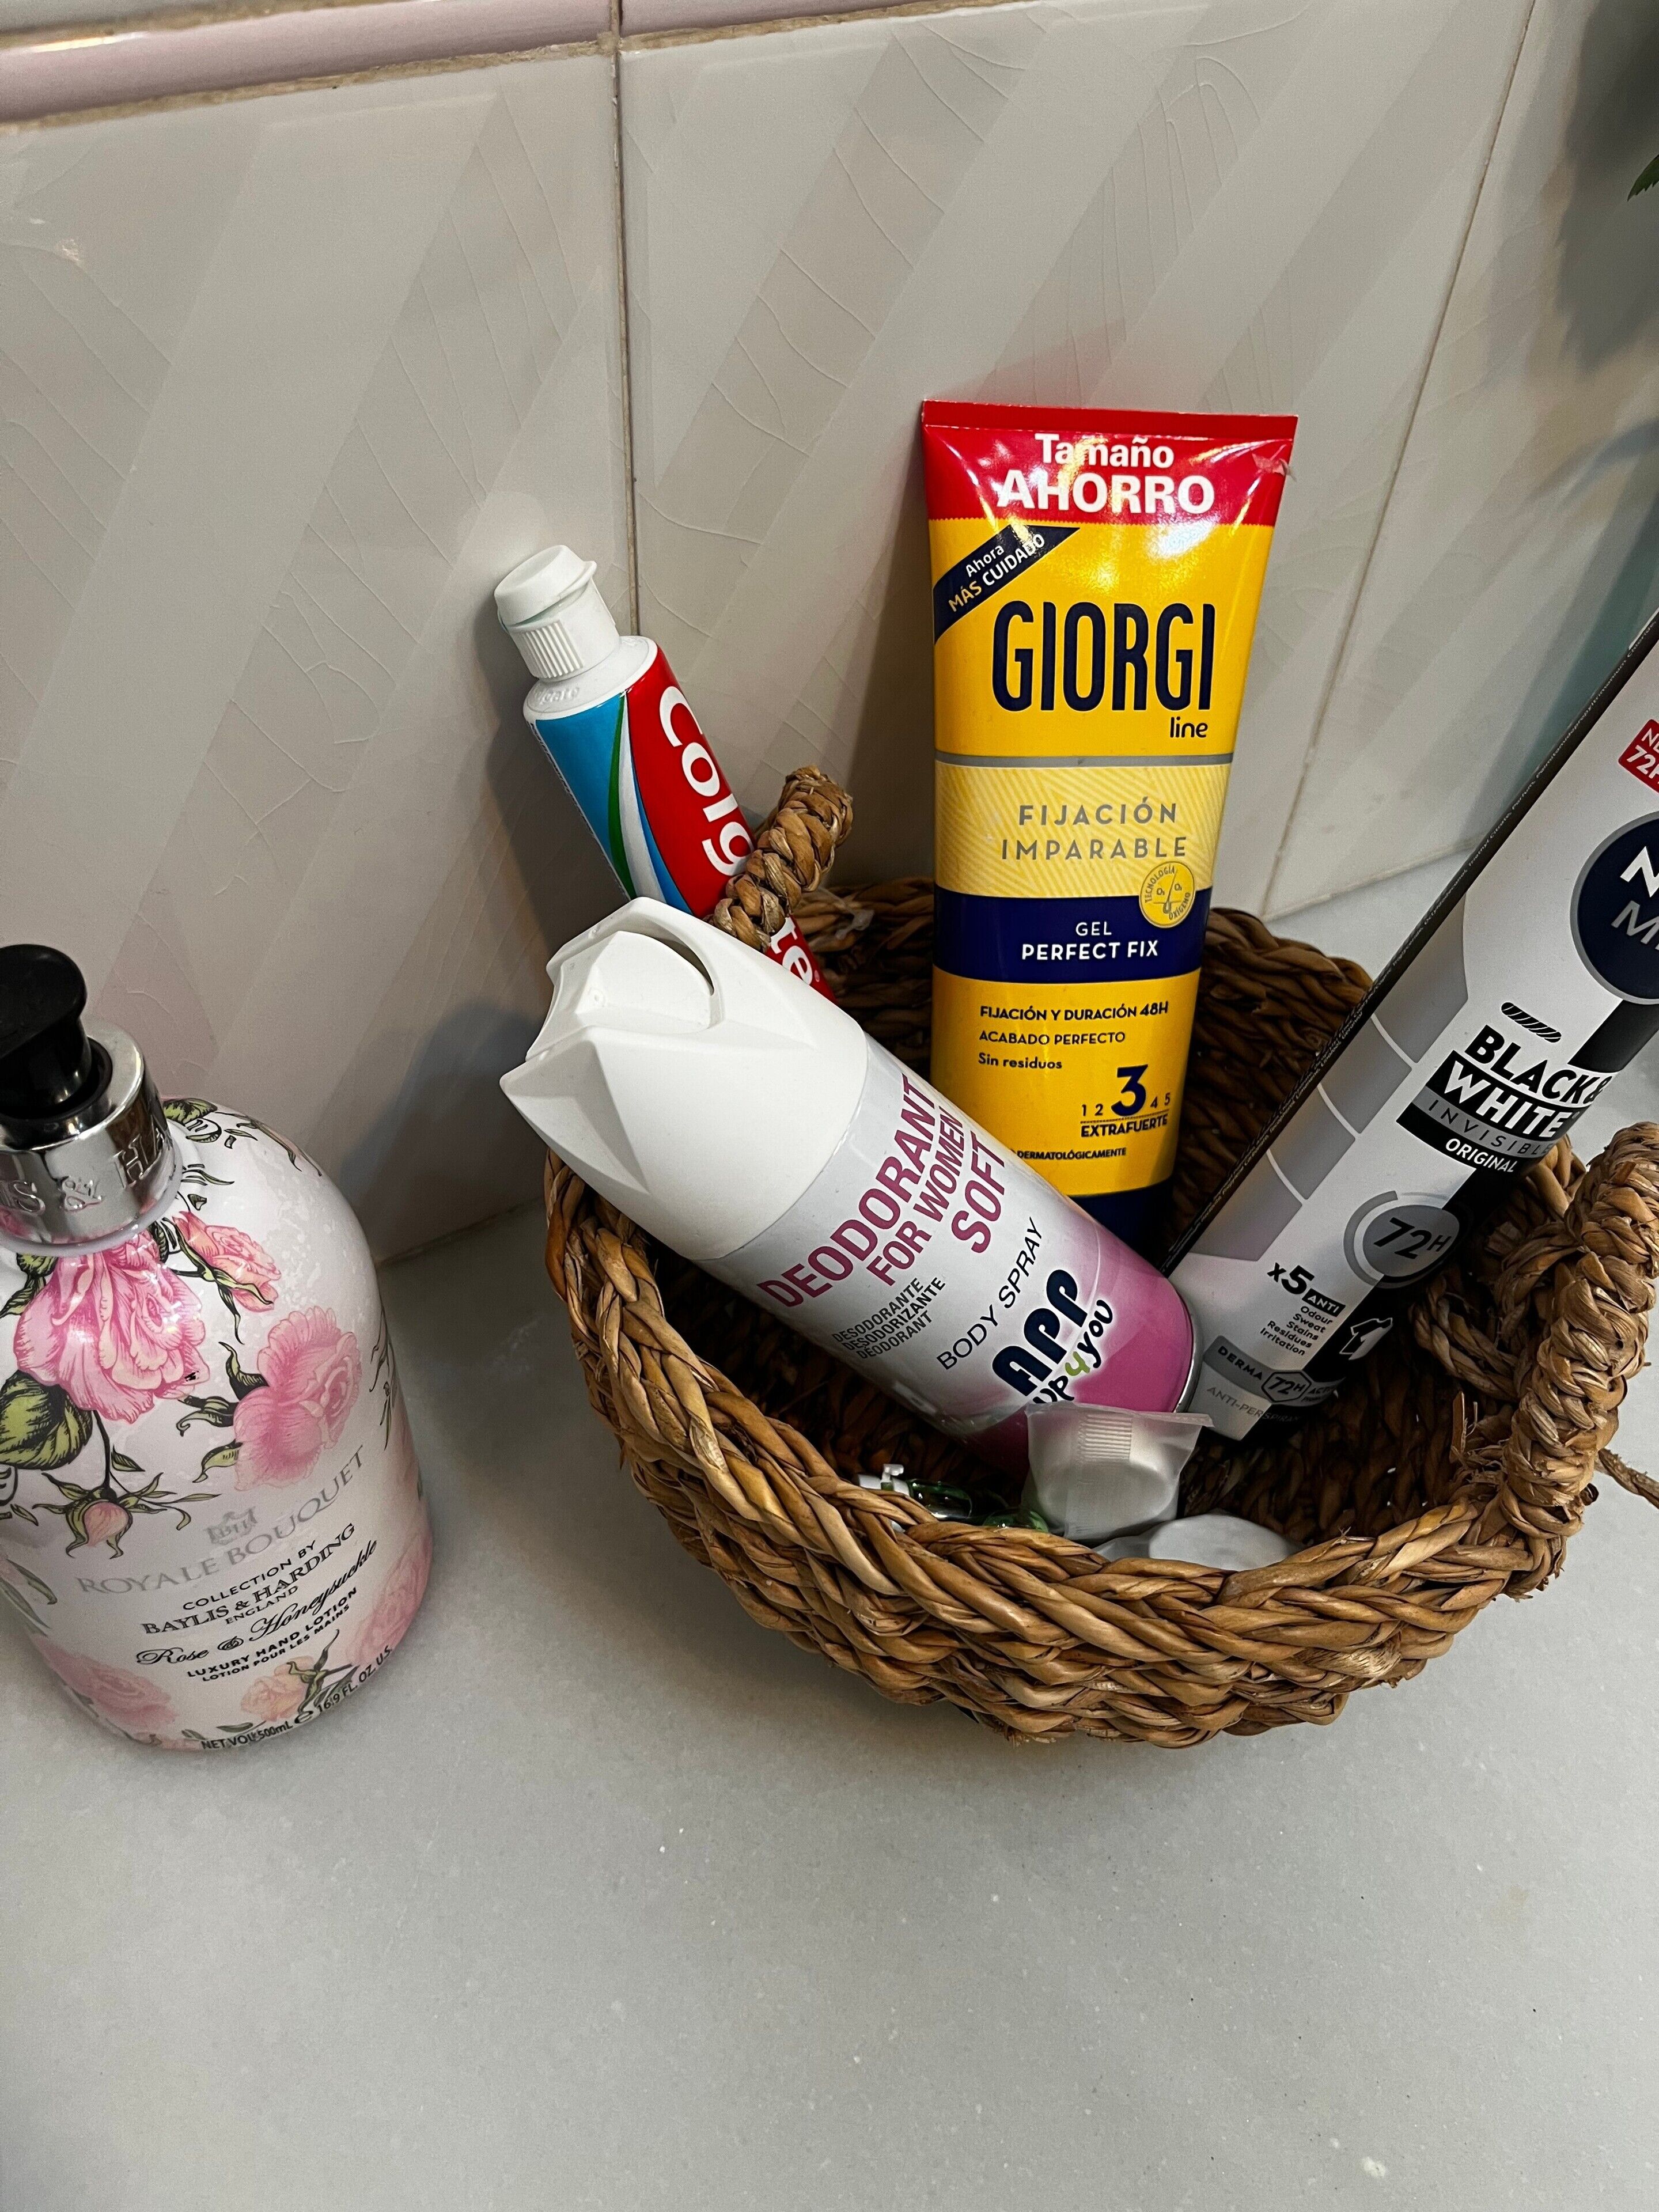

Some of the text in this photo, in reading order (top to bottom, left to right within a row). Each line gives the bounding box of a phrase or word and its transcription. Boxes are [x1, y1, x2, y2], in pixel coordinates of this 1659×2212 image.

[1035, 434, 1174, 468] Tamaño
[997, 469, 1214, 514] AHORRO
[948, 533, 1044, 612] MÁS CUIDADO
[965, 545, 1004, 577] Ahora
[992, 601, 1215, 711] GIORGI
[1170, 717, 1208, 738] line
[1019, 796, 1177, 825] FIJACIÓN
[659, 685, 813, 986] Colgte
[1002, 837, 1187, 860] IMPARABLE
[1022, 940, 1158, 960] PERFECT FIX
[1075, 922, 1112, 937] GEL
[980, 1001, 1168, 1021] FIJACIÓN Y DURACIÓN 48H
[979, 1031, 1125, 1046] ACABADO PERFECTO
[978, 1052, 1062, 1069] Sin residuos
[1082, 1064, 1171, 1116] 1 2 3 4 5
[1444, 1060, 1573, 1138] WHITE
[1081, 1114, 1168, 1138] EXTRAFUERTE
[1429, 1100, 1553, 1154] INVISIBLE
[1017, 1147, 1127, 1160] DERMATOLÓGICAMENTE
[1446, 1138, 1518, 1172] ORIGINAL
[756, 1073, 935, 1308] DEODORANT
[867, 1107, 964, 1286] FOR WOMEN
[951, 1130, 1005, 1253] SOFT
[1373, 1217, 1452, 1259] 72H
[937, 1217, 1043, 1370] BODY SPRAY
[1267, 1262, 1315, 1294] x5
[832, 1278, 923, 1342] DESODORANTE
[842, 1277, 946, 1350] DESODORIZANTE
[1293, 1313, 1326, 1333] Sweat
[1301, 1306, 1332, 1324] Odour
[1308, 1295, 1339, 1313] ANTI
[993, 1269, 1088, 1396] APP
[1260, 1327, 1305, 1355] Irritation
[1267, 1320, 1312, 1348] Residues
[1286, 1321, 1319, 1340] Stains
[1218, 1346, 1262, 1380] DERMA
[1268, 1377, 1306, 1395] 72H
[75, 1557, 221, 1594] ROYALE
[228, 1445, 363, 1566] BOUQUET
[142, 1604, 230, 1635] BAYLIS
[234, 1600, 249, 1611] &
[252, 1522, 355, 1604] HARDING
[183, 1540, 317, 1611] COLLECTION BY
[137, 1647, 209, 1665] Rose
[249, 1540, 377, 1642] Honeysuckle
[226, 1585, 299, 1625] ENGLAND
[187, 1587, 357, 1677] LUXURY HAND LOTION
[203, 1603, 350, 1681] LOTION POUR LES MAINS
